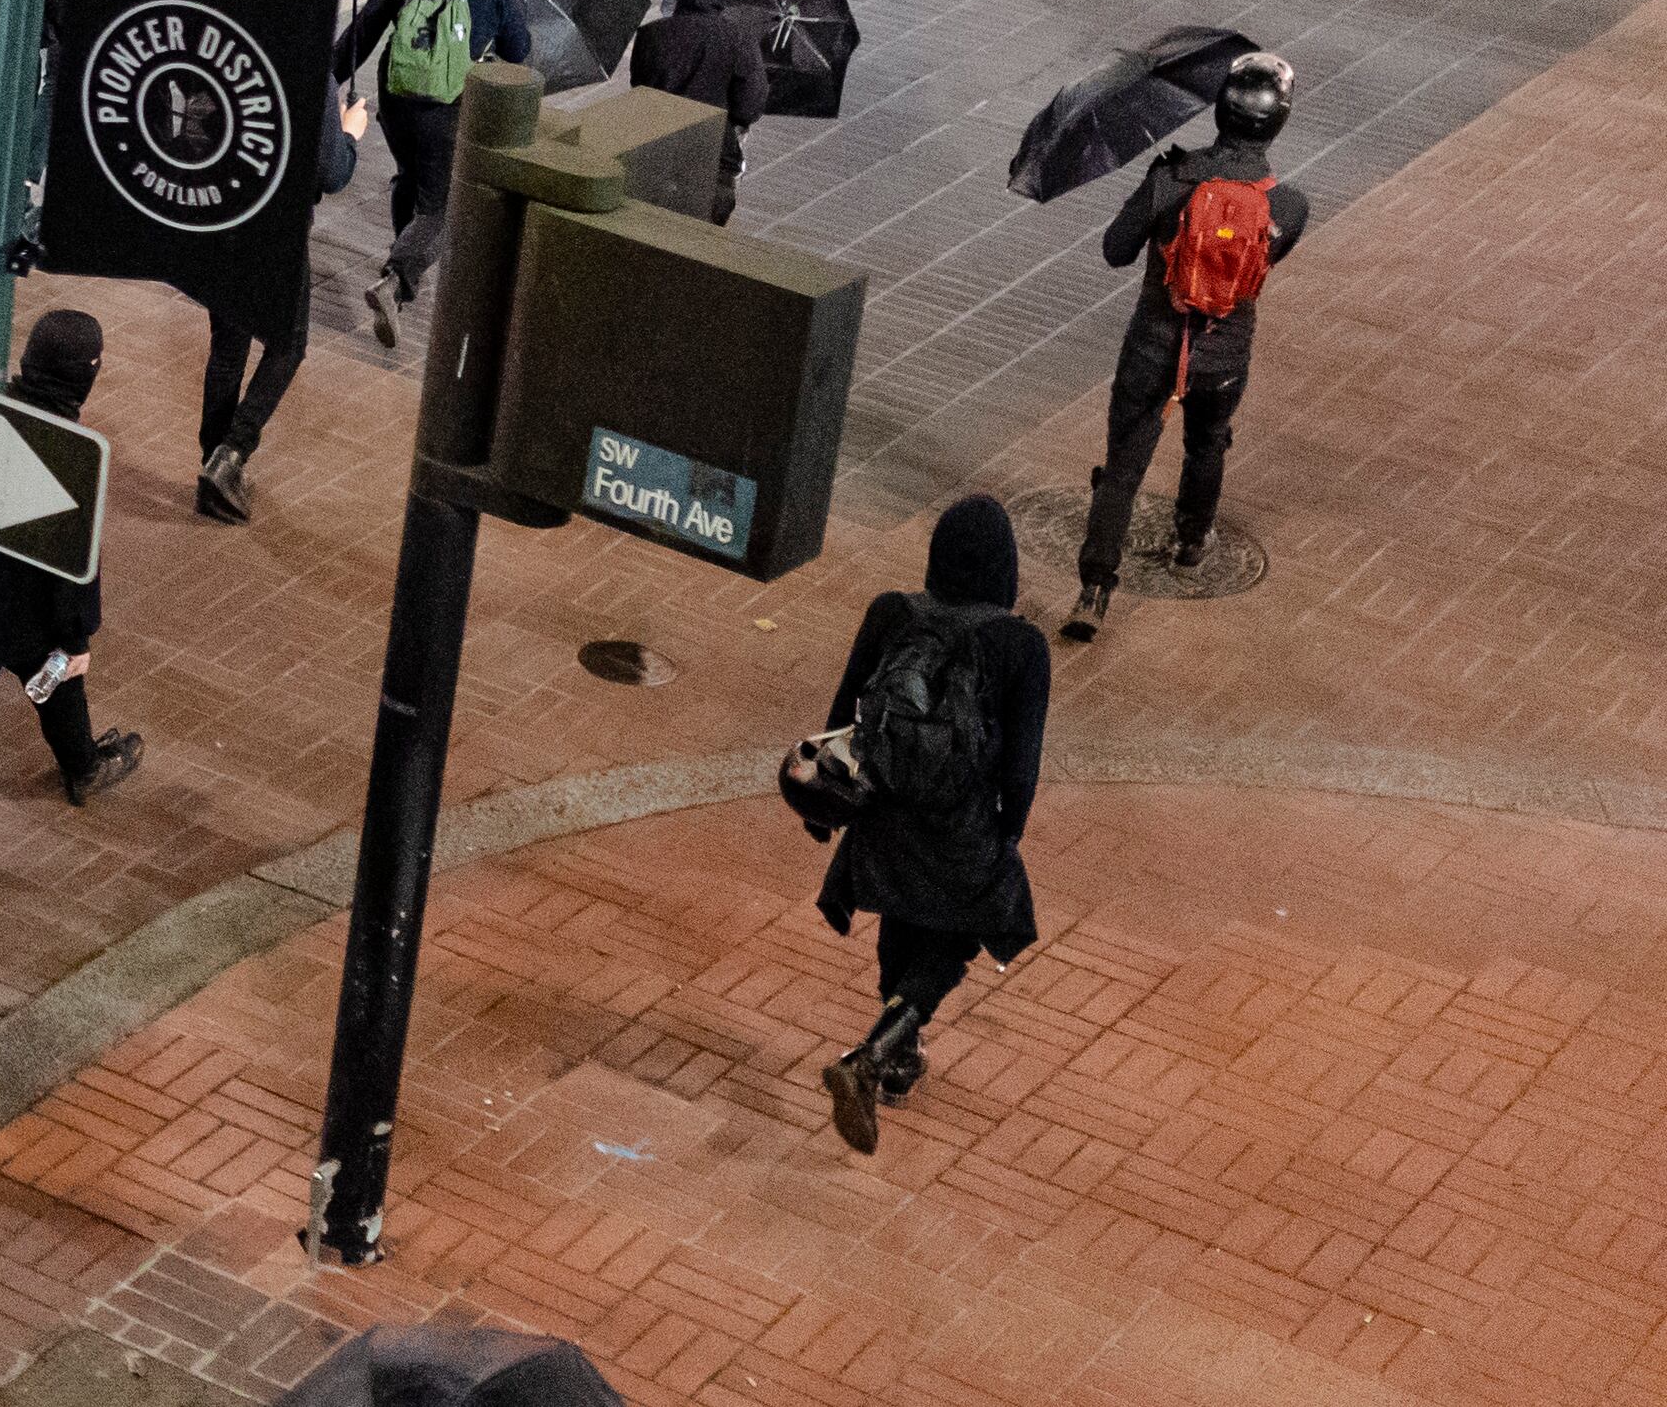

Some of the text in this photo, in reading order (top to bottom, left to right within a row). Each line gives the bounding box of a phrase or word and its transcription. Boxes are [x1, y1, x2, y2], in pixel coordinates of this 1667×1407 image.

[97, 16, 276, 177] PIONEER DISTRICT
[131, 162, 223, 207] PORTLAND
[599, 436, 640, 470] SW
[593, 466, 735, 544] Fourth Ave
